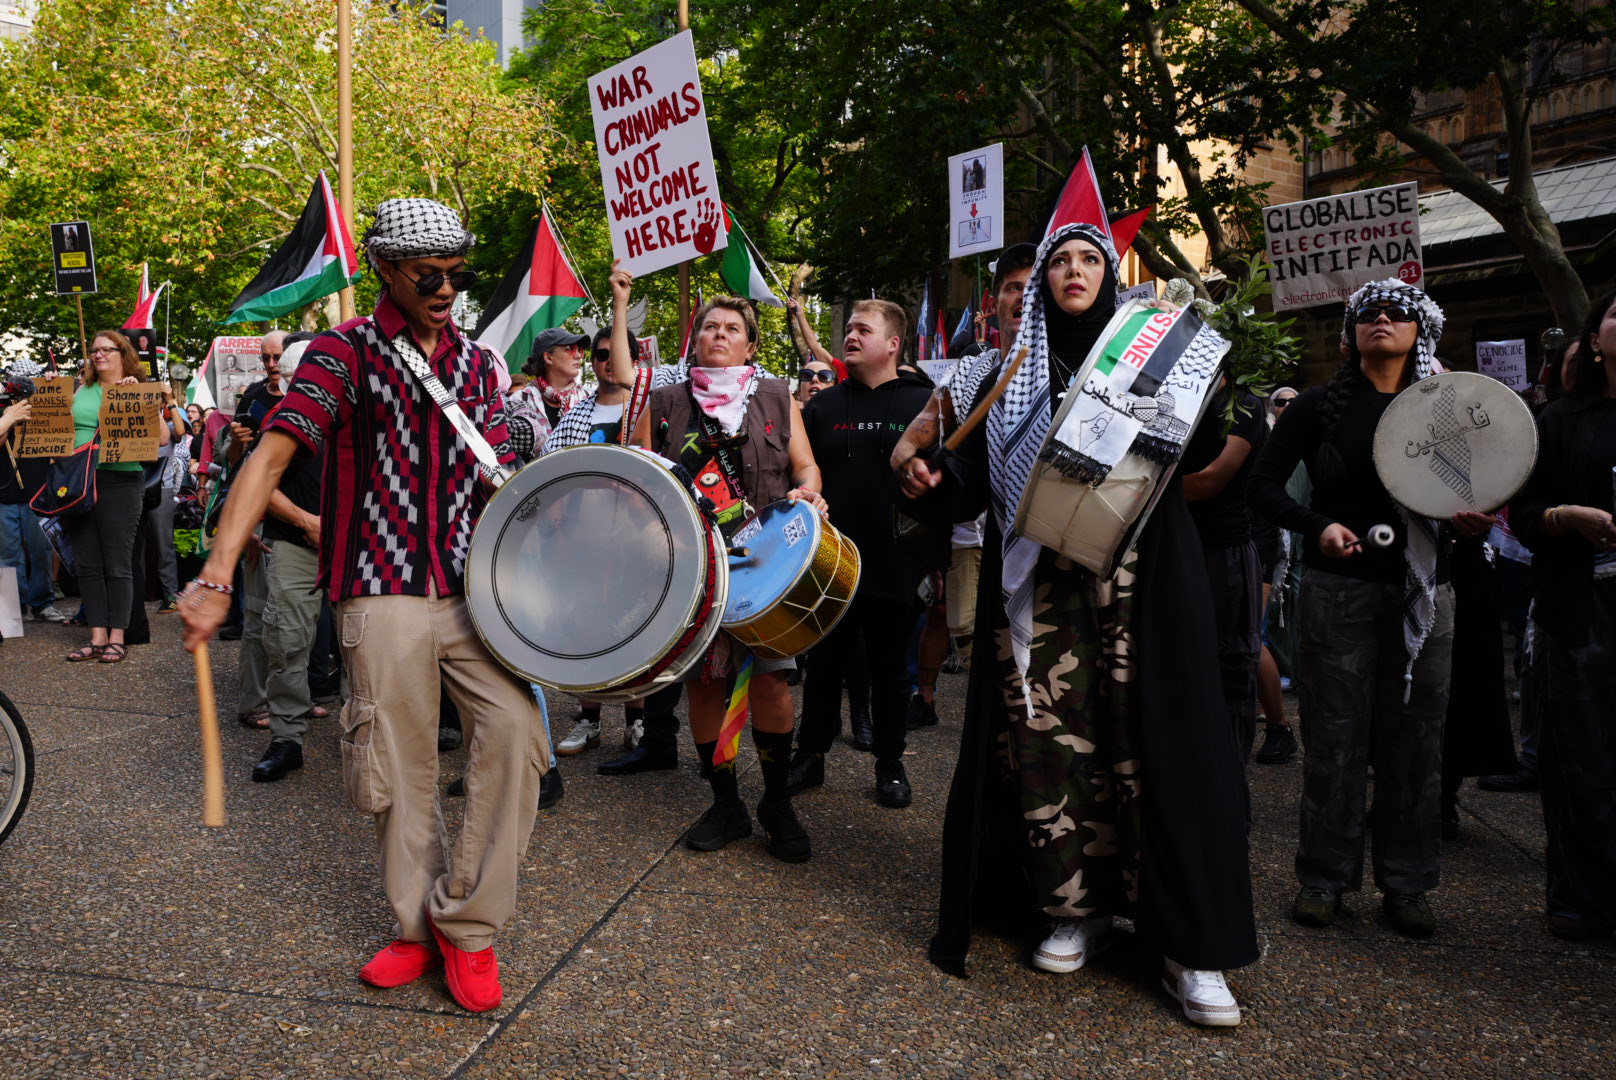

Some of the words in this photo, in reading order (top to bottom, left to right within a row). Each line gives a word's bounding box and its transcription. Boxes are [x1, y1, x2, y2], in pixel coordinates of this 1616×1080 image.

[597, 65, 653, 111] WAR
[604, 82, 701, 156] CRIMINALS
[615, 142, 661, 194] NOT
[610, 161, 709, 222] WELCOME
[1266, 187, 1413, 233] GLOBALISE
[624, 208, 692, 259] HERE
[1271, 220, 1413, 256] ELECTRONIC
[1273, 237, 1419, 281] INTIFADA
[1399, 265, 1418, 279] ei
[1478, 344, 1524, 358] GENOCIDE
[1491, 364, 1519, 373] CRIME
[28, 395, 67, 405] LBANESE
[107, 389, 141, 400] Shame
[143, 392, 154, 400] on
[109, 401, 141, 413] ALBO
[104, 416, 123, 426] our
[127, 415, 145, 429] pm
[833, 422, 905, 432] PALESTNE
[108, 428, 148, 441] ignores
